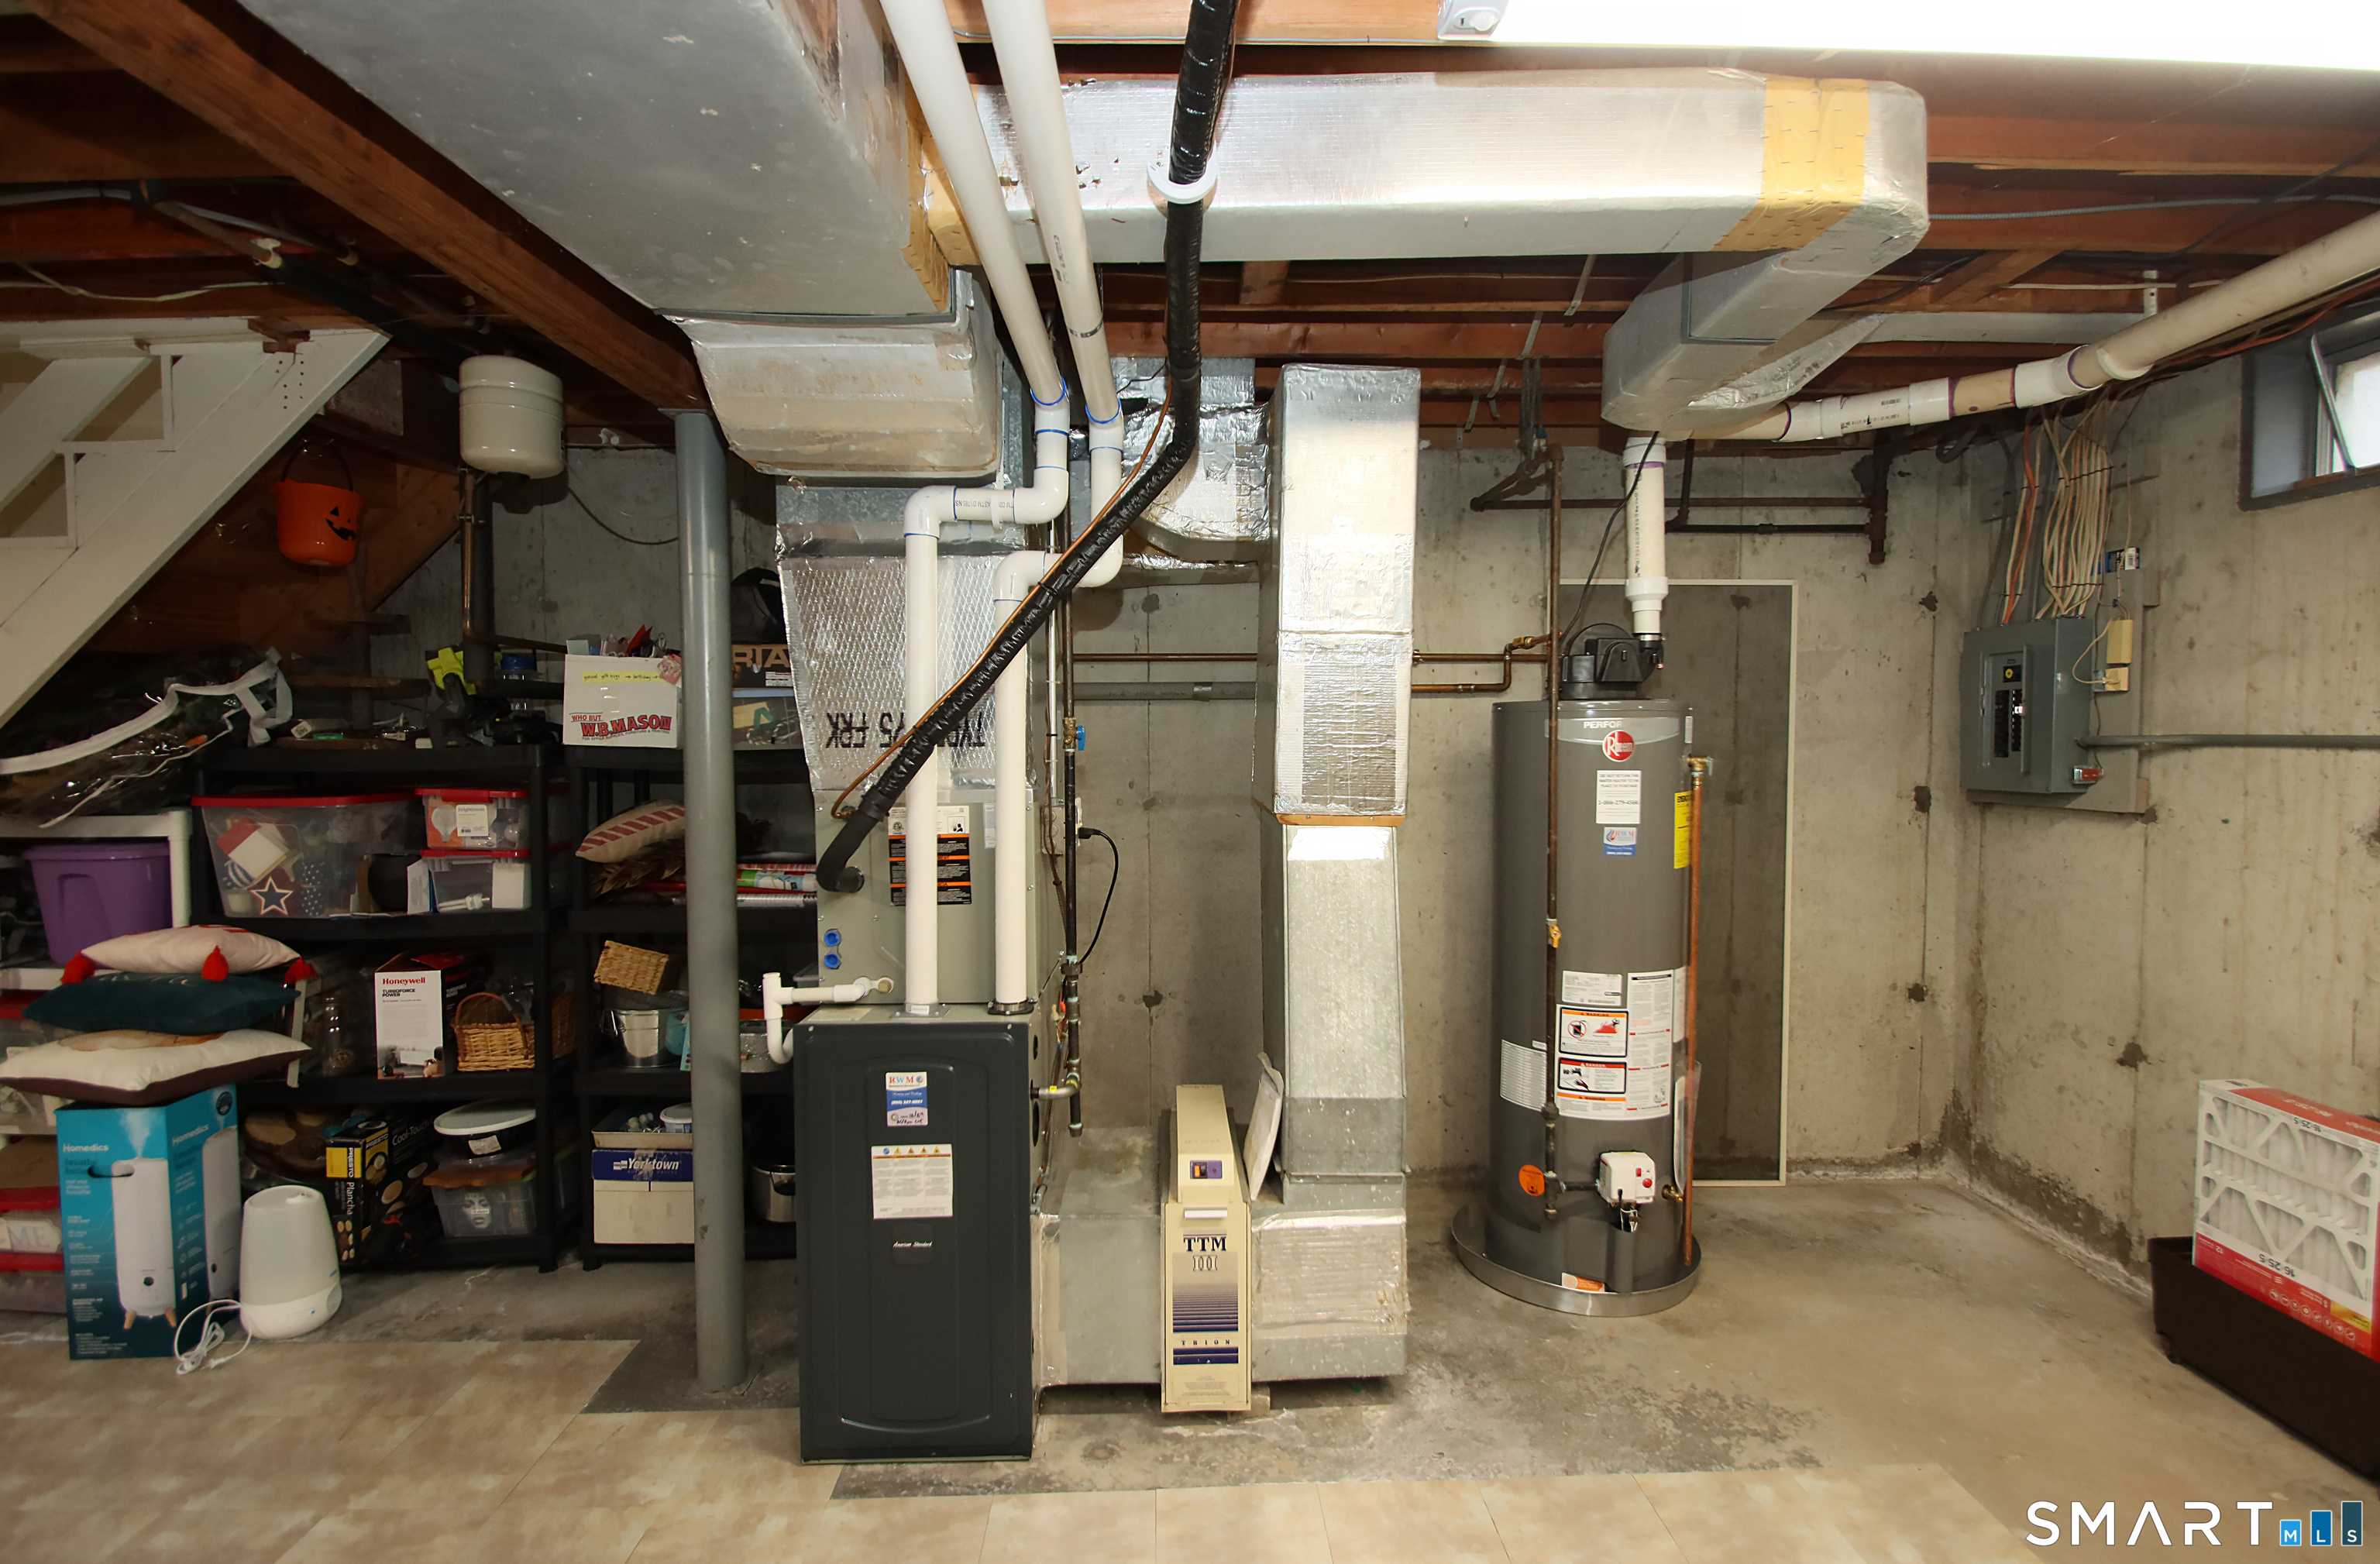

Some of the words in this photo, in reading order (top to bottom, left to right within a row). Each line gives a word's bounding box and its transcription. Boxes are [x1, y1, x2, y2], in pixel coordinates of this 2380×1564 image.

[580, 714, 672, 737] W.B.MASON
[825, 712, 869, 748] FRK
[1607, 731, 1633, 757] Rheem
[383, 977, 426, 985] Honeywell
[2300, 1119, 2310, 1129] 25
[2313, 1122, 2322, 1133] 16
[172, 1123, 208, 1145] Homedics
[366, 1133, 389, 1150] PRESTO
[63, 1143, 109, 1153] Homedics
[64, 1157, 98, 1166] breathe
[628, 1158, 679, 1170] Yorktown
[65, 1167, 88, 1175] bette
[346, 1181, 355, 1215] Plancha
[1183, 1236, 1227, 1252] TTM
[2215, 1246, 2224, 1254] 12
[2258, 1253, 2265, 1263] 5
[2268, 1260, 2282, 1271] 25
[2284, 1266, 2296, 1277] 16
